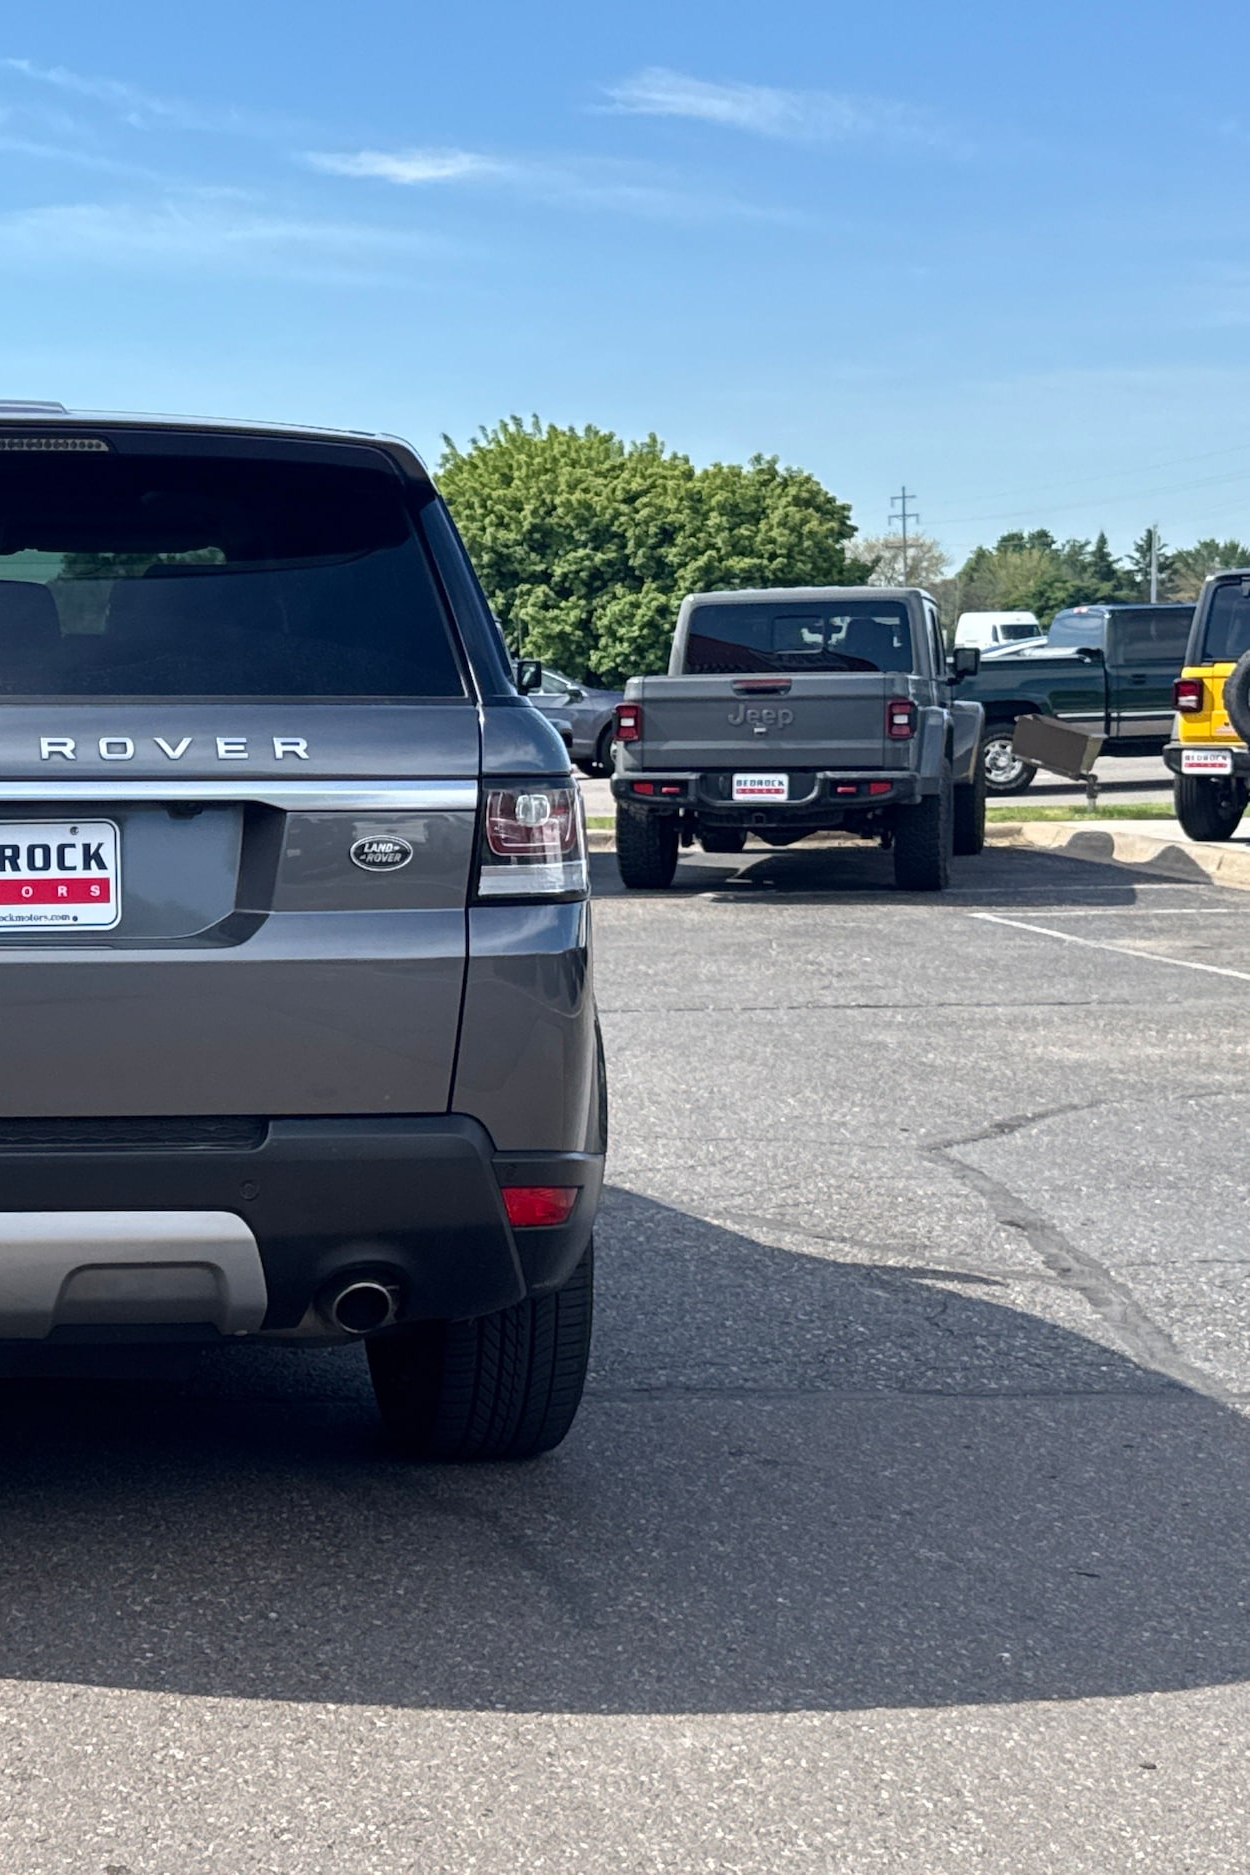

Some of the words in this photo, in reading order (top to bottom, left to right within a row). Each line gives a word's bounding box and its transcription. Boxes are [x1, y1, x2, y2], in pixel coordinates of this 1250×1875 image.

[728, 703, 793, 728] Jeep
[40, 736, 310, 762] ROVER
[364, 843, 394, 853] LAND
[365, 852, 402, 863] ROVER
